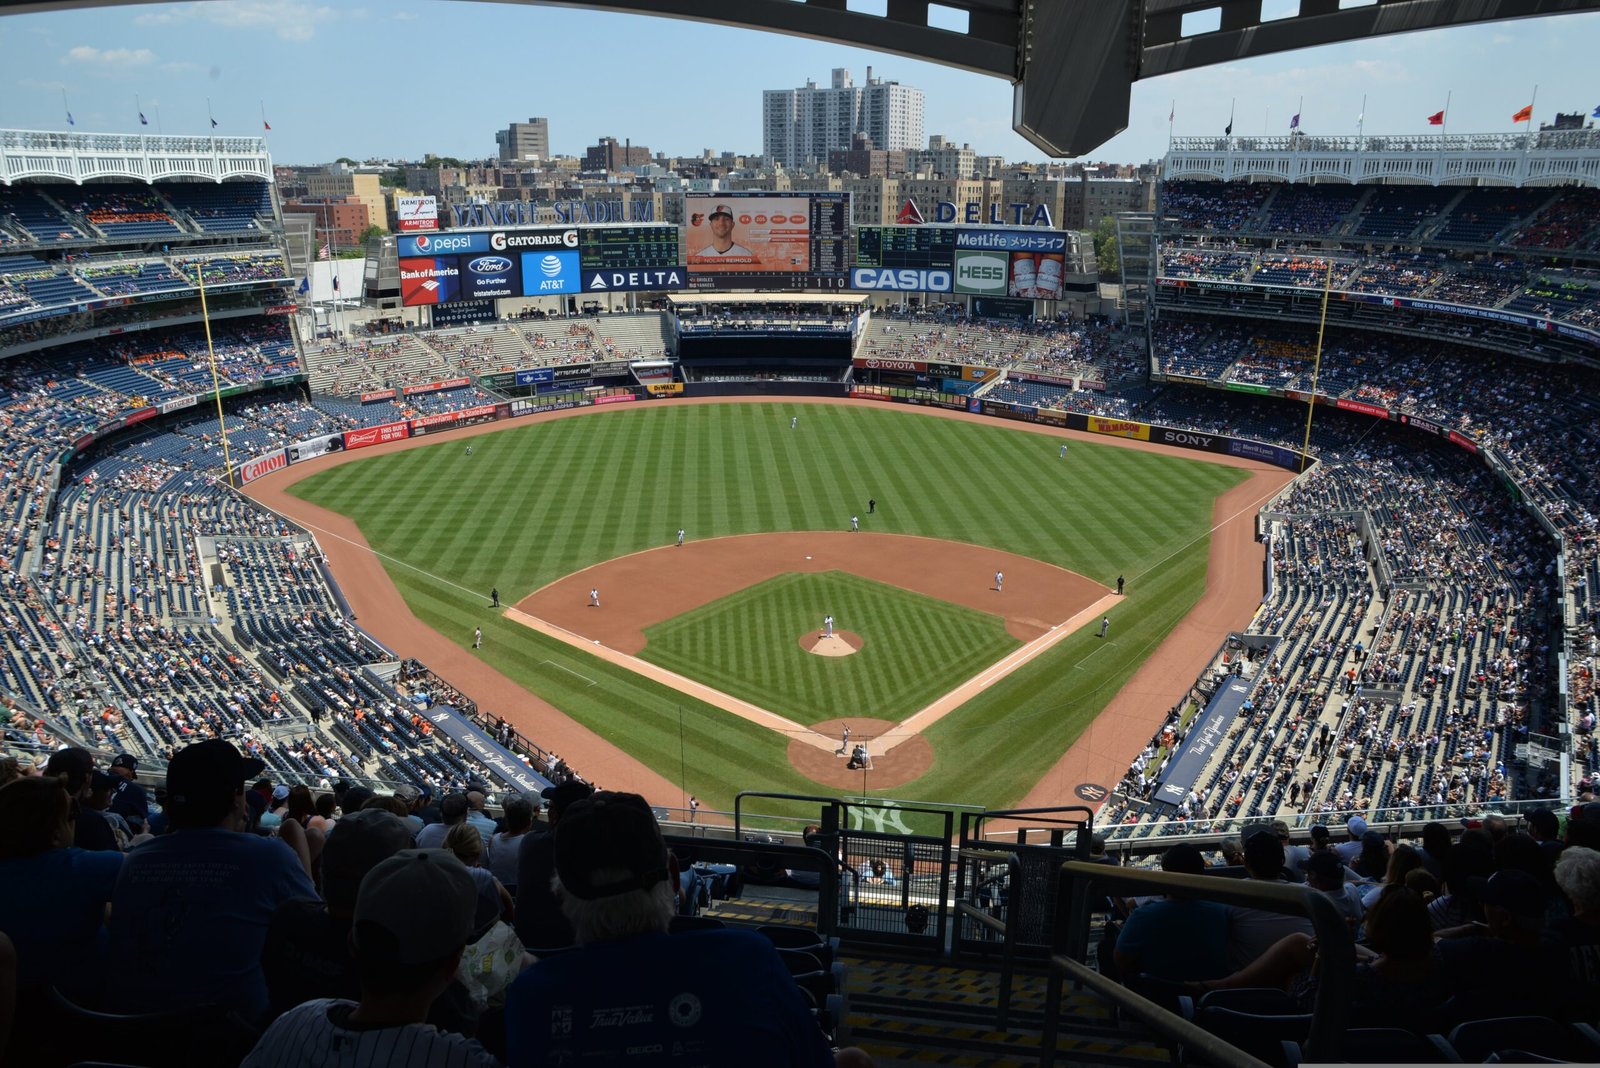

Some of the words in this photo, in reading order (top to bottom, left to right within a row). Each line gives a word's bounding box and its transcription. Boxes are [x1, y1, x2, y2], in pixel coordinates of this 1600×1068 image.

[450, 200, 541, 228] YANKEE
[554, 200, 655, 224] STADIUM
[938, 202, 1053, 227] DELTA
[434, 236, 470, 251] pepsi
[508, 236, 562, 246] GATORADE
[957, 232, 1006, 246] MetLife
[1010, 237, 1066, 249] メットライフ
[477, 258, 504, 272] Ford
[401, 270, 420, 279] Bank
[420, 269, 428, 278] of
[428, 267, 459, 277] America
[613, 272, 680, 286] DELTA
[854, 269, 950, 291] CASIO
[960, 266, 1003, 280] HESS
[540, 280, 564, 290] AT&T
[817, 278, 820, 287] 1
[828, 278, 831, 287] 1
[838, 278, 844, 287] 0
[474, 289, 511, 297] tristateford.com
[1412, 301, 1427, 309] FEDEX
[881, 360, 916, 370] TOYOTA
[164, 397, 195, 410] RUTGERS
[513, 408, 532, 417] StubHub
[533, 405, 552, 413] StubHub
[1164, 432, 1212, 447] SONY
[242, 452, 286, 482] Canon
[1205, 715, 1224, 736] Yankees
[462, 734, 488, 757] Welcome
[484, 754, 516, 775] Yankee
